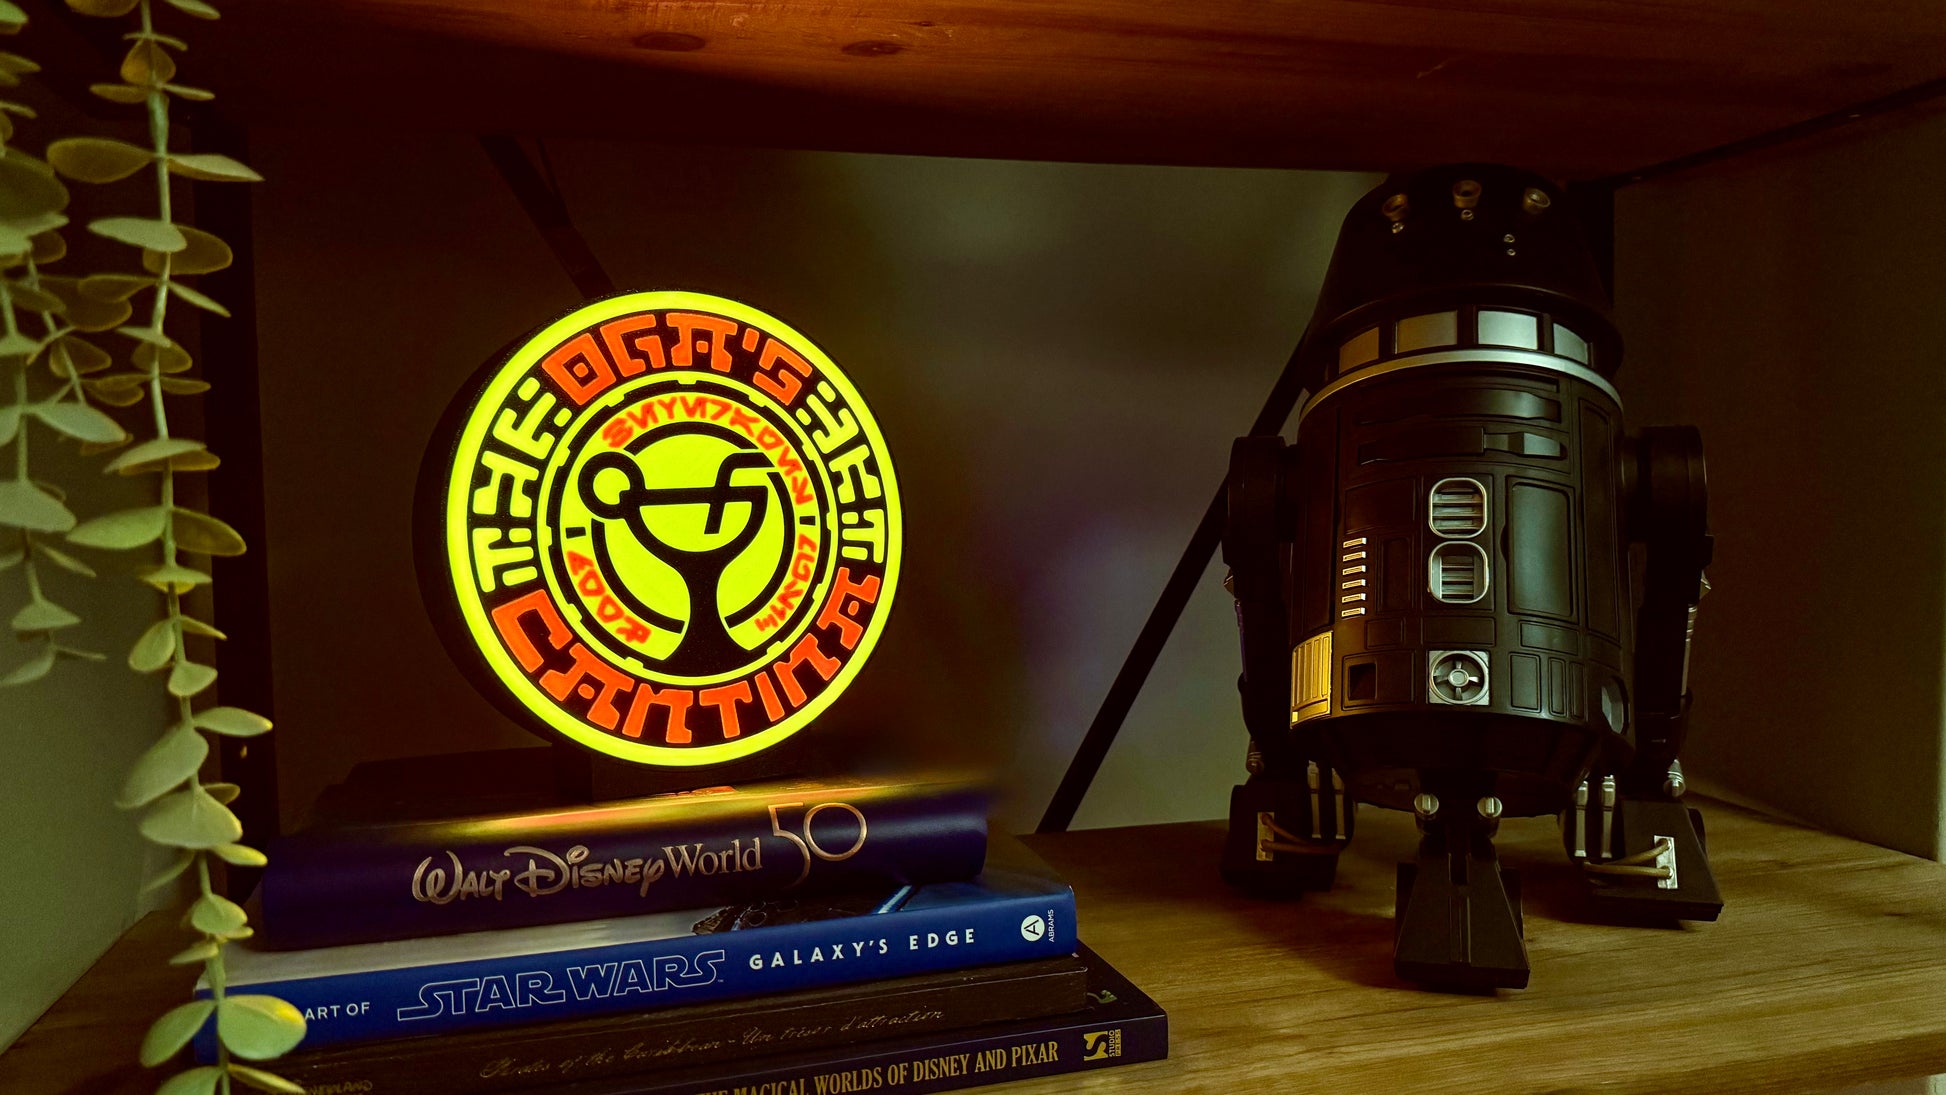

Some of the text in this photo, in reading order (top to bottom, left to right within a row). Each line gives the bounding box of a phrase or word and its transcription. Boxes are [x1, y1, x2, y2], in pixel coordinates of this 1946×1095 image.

[541, 312, 813, 406] OGA'S
[491, 566, 881, 744] CANTINA
[661, 837, 763, 877] World
[767, 802, 868, 887] 50
[1047, 909, 1055, 943] ABRAMS
[305, 928, 975, 1021] ART OF STAR WARS GALAXY'S EDGE
[814, 1066, 882, 1095] WORLDS
[887, 1062, 909, 1087] OF
[913, 1052, 970, 1083] DISNEY
[974, 1048, 1007, 1073] AND
[1011, 1041, 1059, 1068] PIXAR
